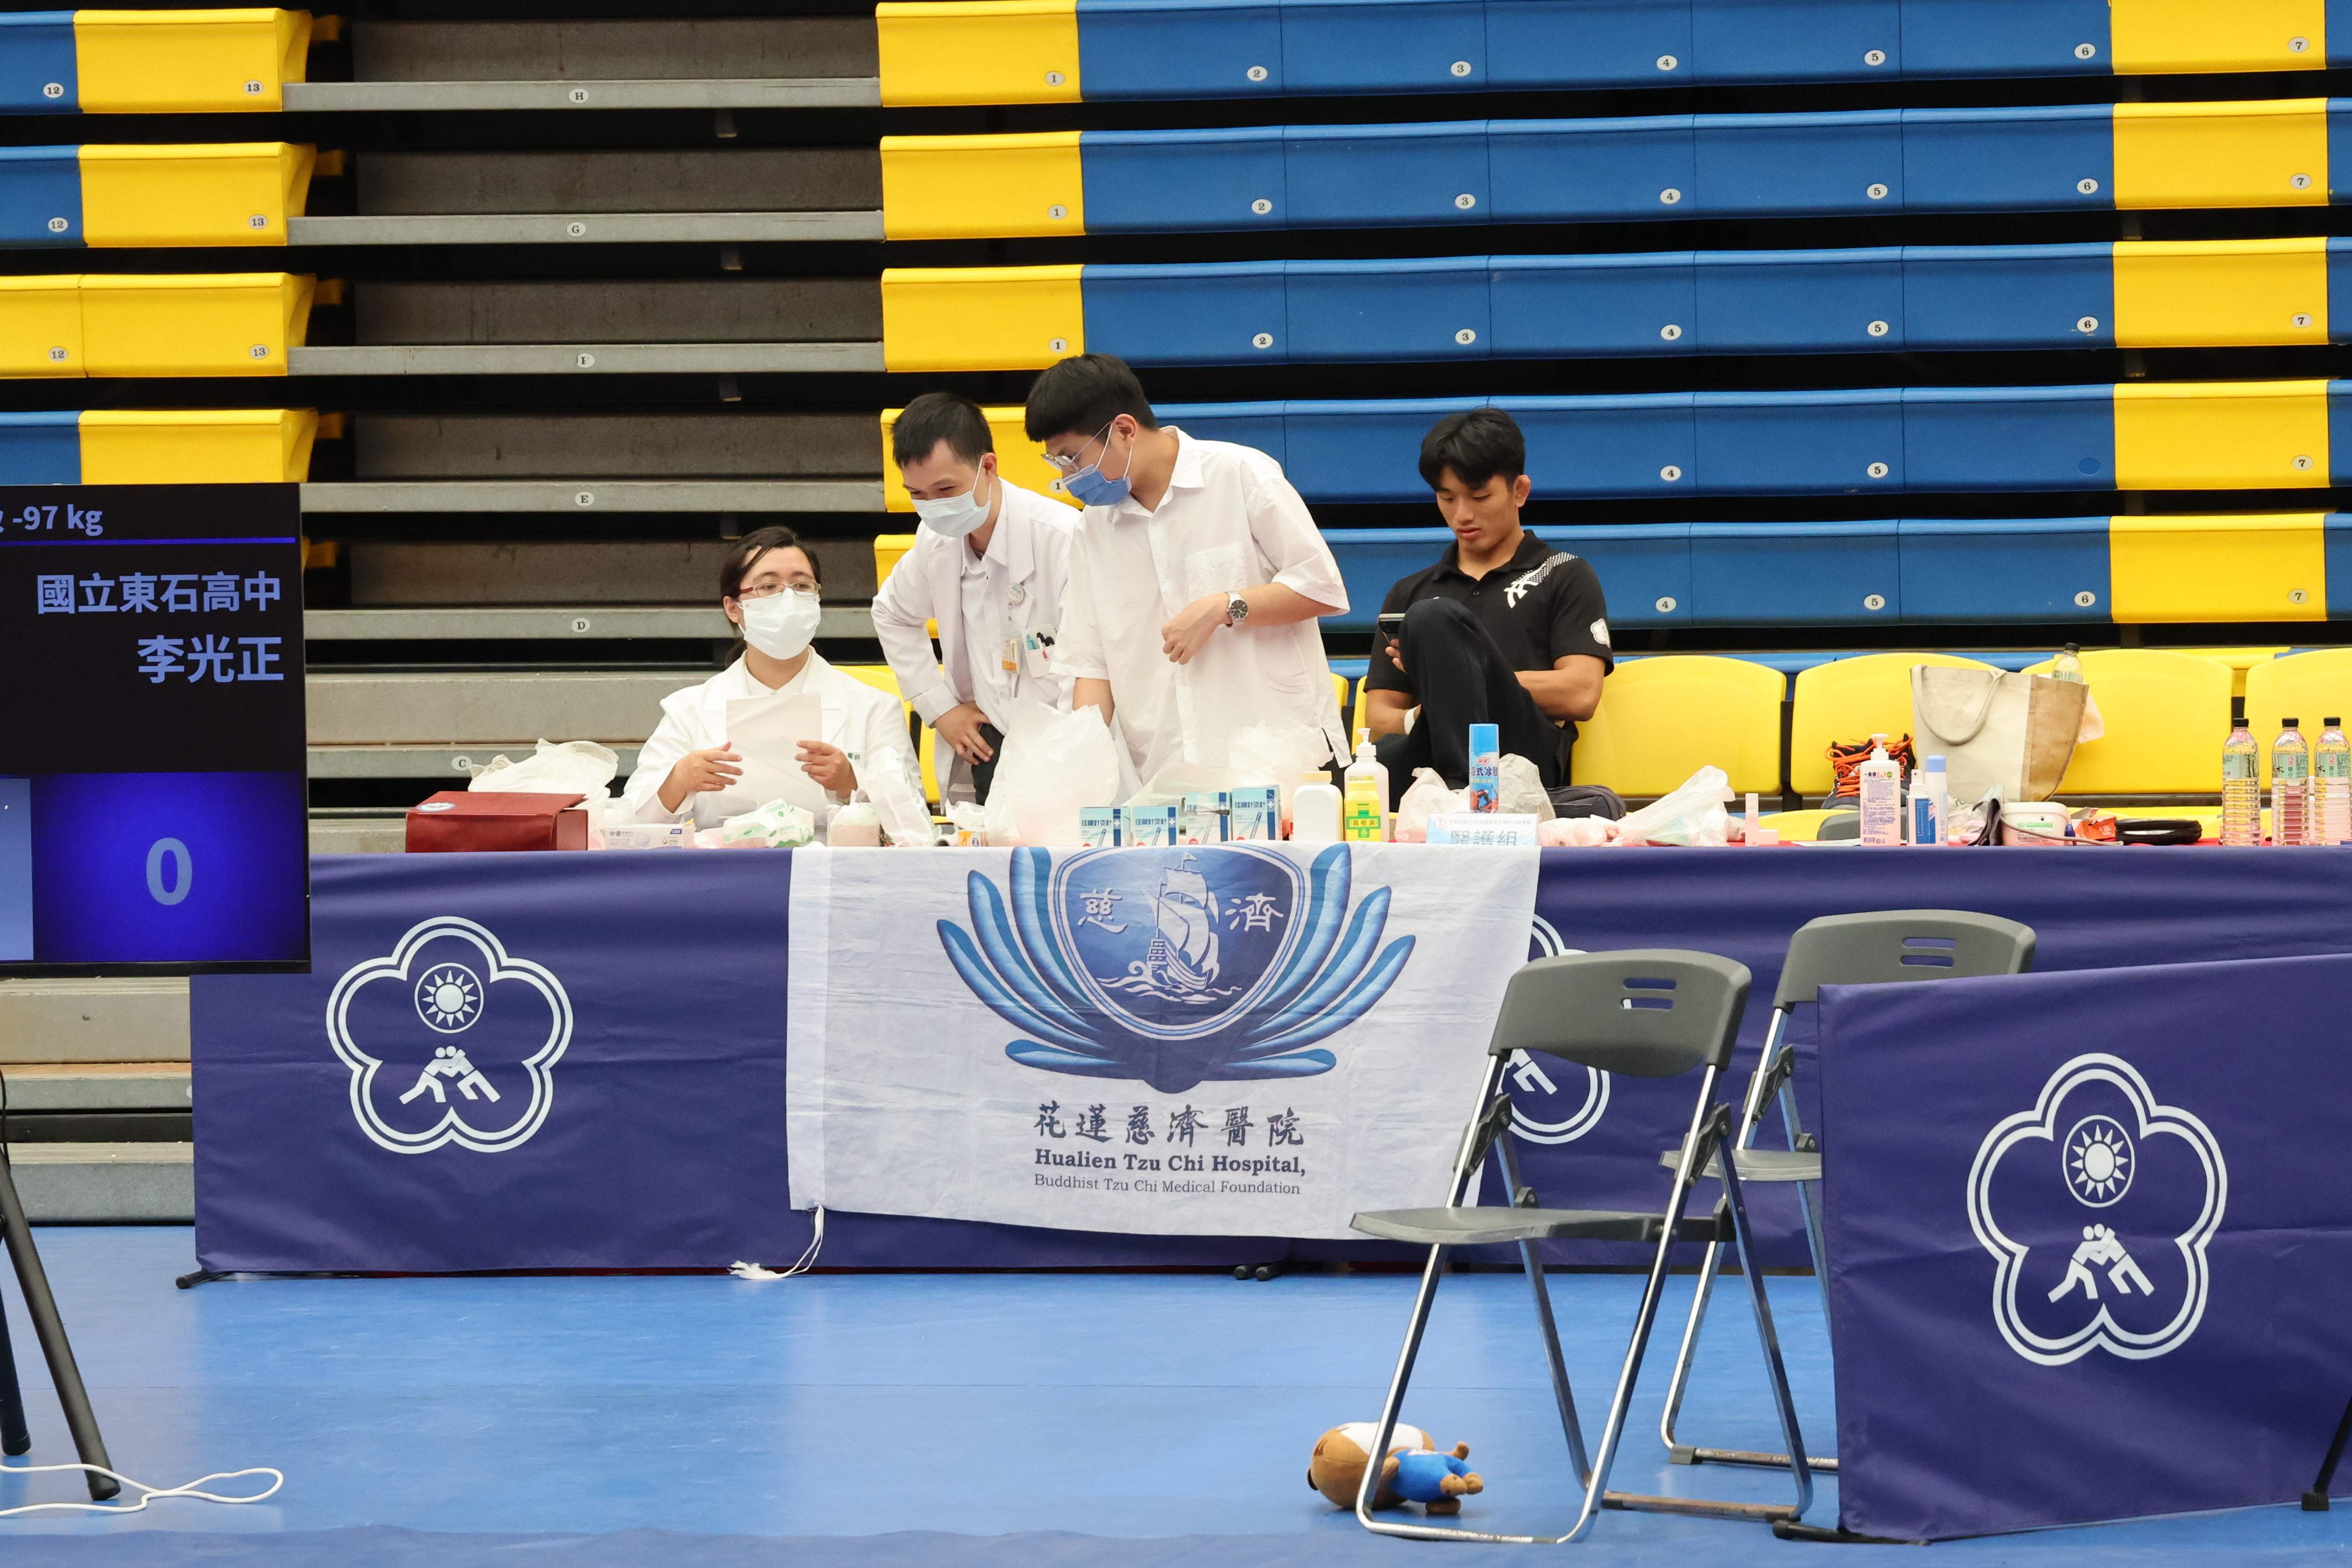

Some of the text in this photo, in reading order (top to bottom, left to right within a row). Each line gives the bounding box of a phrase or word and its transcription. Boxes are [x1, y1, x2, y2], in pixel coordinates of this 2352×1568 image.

[2295, 41, 2303, 50] 7
[2082, 47, 2089, 56] 6
[1872, 53, 1879, 62] 5
[1663, 59, 1670, 67] 4
[1457, 64, 1464, 73] 3
[1254, 69, 1260, 78] 2
[1052, 74, 1056, 83] 1
[47, 86, 60, 95] 12
[247, 84, 260, 92] 13
[575, 92, 584, 100] H
[2297, 177, 2304, 186] 7
[2084, 182, 2091, 191] 6
[1667, 192, 1674, 200] 4
[1874, 187, 1881, 196] 5
[1462, 197, 1469, 205] 3
[1258, 202, 1265, 211] 2
[1054, 208, 1059, 217] 1
[51, 220, 64, 229] 12
[252, 218, 265, 226] 13
[571, 225, 579, 233] G
[2084, 320, 2092, 329] 6
[2297, 317, 2305, 325] 7
[1668, 328, 1675, 336] 4
[1874, 324, 1882, 333] 5
[1259, 337, 1266, 345] 2
[1462, 333, 1469, 341] 3
[1055, 341, 1061, 350] 1
[52, 350, 65, 359] 12
[253, 348, 266, 357] 13
[2298, 459, 2306, 467] 7
[1667, 469, 1674, 477] 4
[1874, 466, 1881, 474] 5
[580, 495, 589, 503] E
[13, 506, 58, 530] -97
[68, 504, 103, 536] kg
[37, 571, 280, 614] 國立東石高中
[2295, 592, 2302, 601] 7
[1871, 598, 1878, 606] 5
[2081, 595, 2089, 603] 6
[577, 621, 586, 630] D
[138, 634, 283, 683] 李光正
[459, 759, 466, 768] C
[146, 837, 193, 906] 0
[1077, 887, 1284, 934] 慈 濟
[1033, 1100, 1304, 1148] 花蓮慈濟醫院
[1035, 1149, 1306, 1176] Hualien Tzu Chi Hospital,
[1034, 1174, 1300, 1194] Buddhist Tzu Chi Medical Foundation
